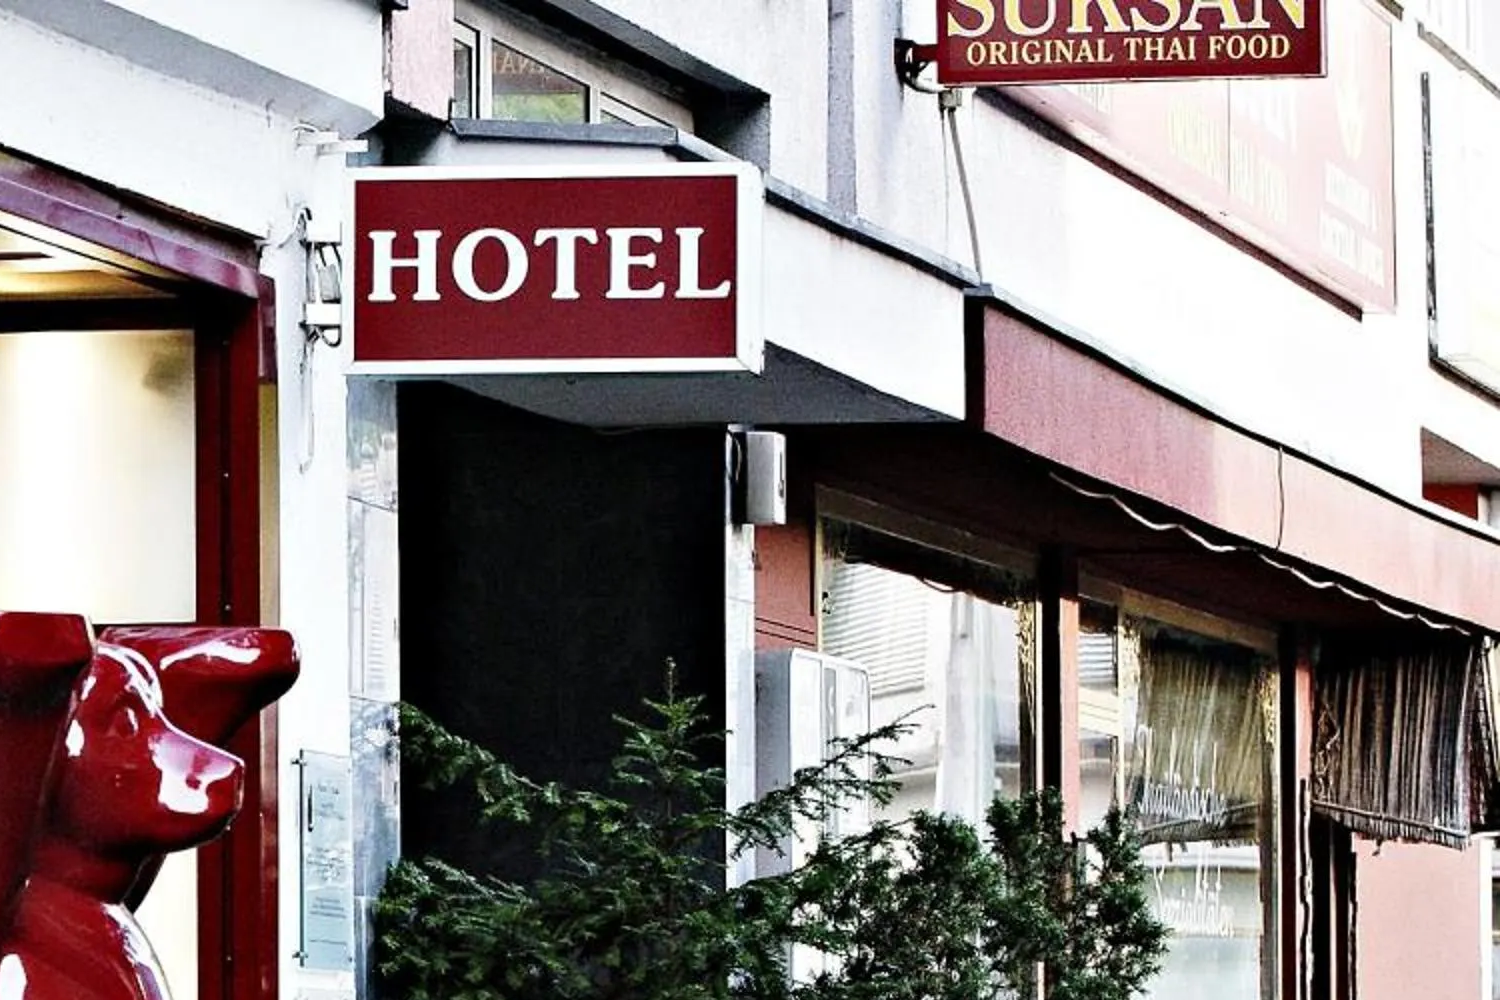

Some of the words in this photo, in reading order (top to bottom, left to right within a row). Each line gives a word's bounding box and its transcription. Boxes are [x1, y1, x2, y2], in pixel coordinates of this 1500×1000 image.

[947, 0, 1305, 37] SUKSAN
[966, 38, 1114, 66] ORIGINAL
[1123, 35, 1197, 62] THAI
[1208, 34, 1291, 60] FOOD
[366, 227, 732, 303] HOTEL
